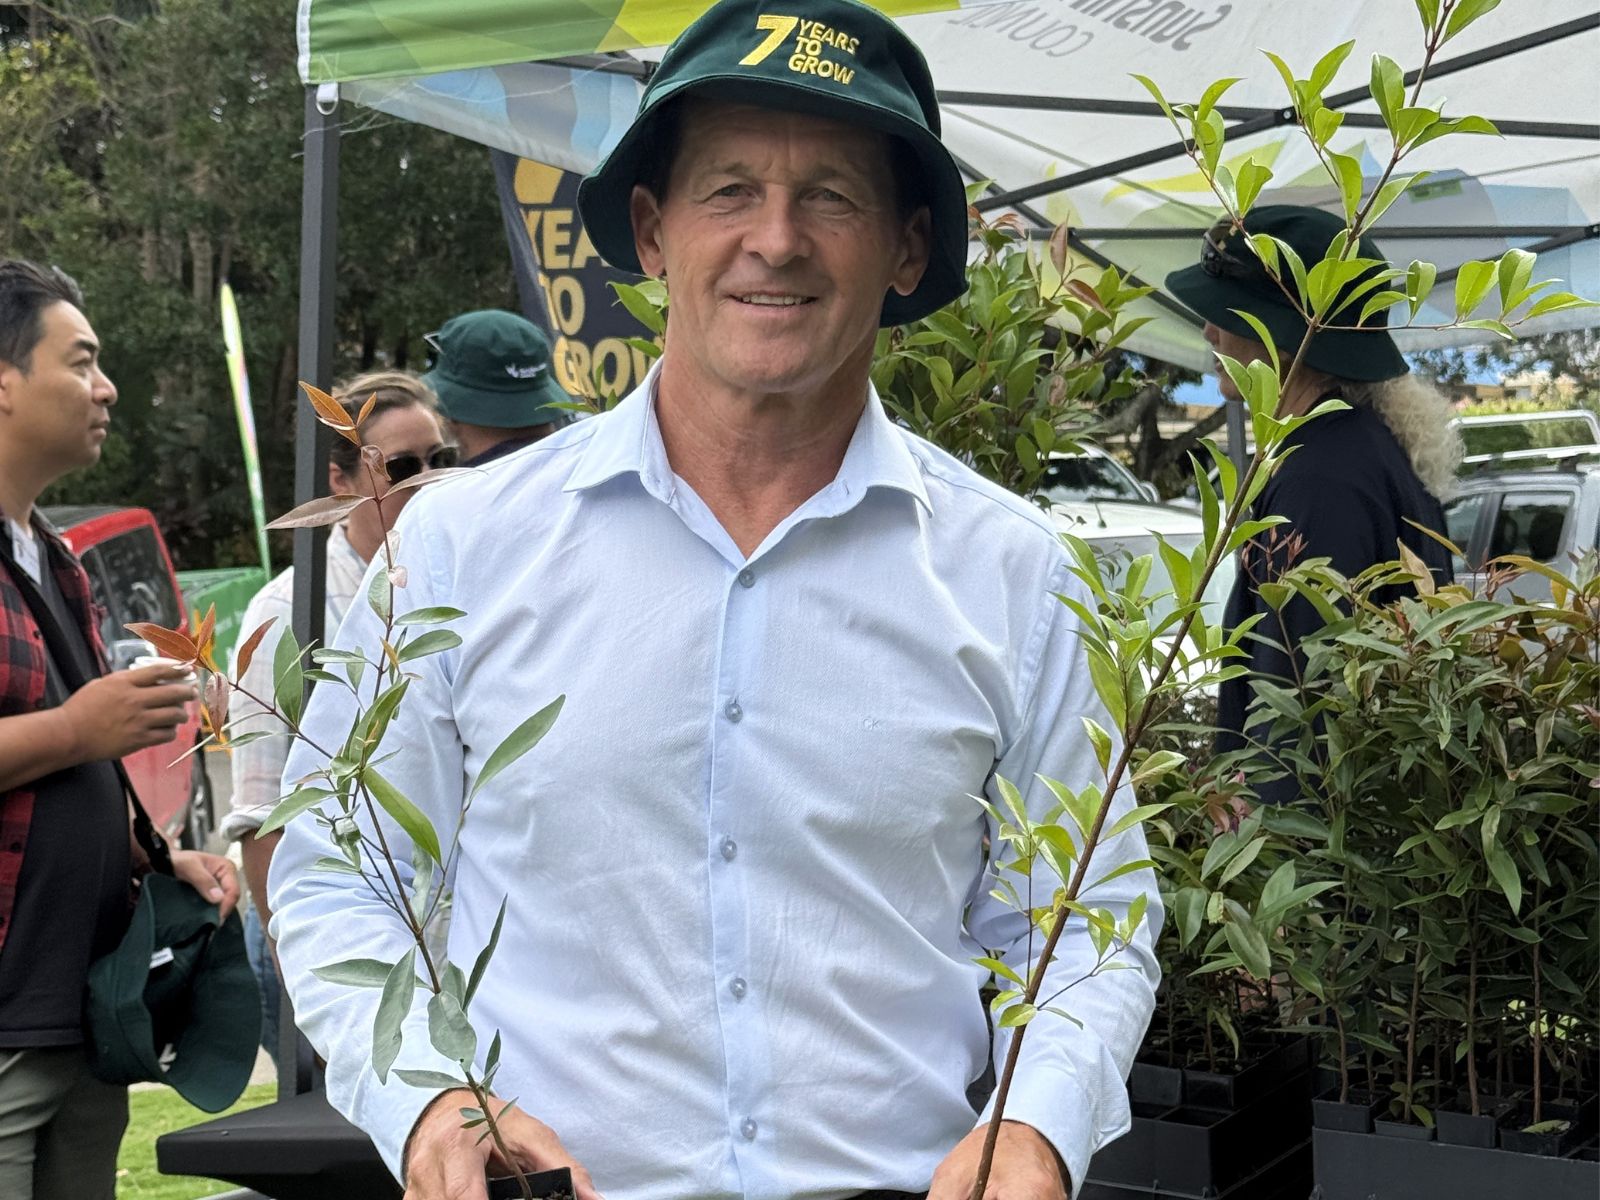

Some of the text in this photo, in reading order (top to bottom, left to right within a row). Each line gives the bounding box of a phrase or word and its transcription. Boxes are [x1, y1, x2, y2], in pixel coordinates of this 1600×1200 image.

[738, 14, 860, 66] 7 YEARS
[794, 36, 822, 56] TO
[787, 53, 855, 85] GROW
